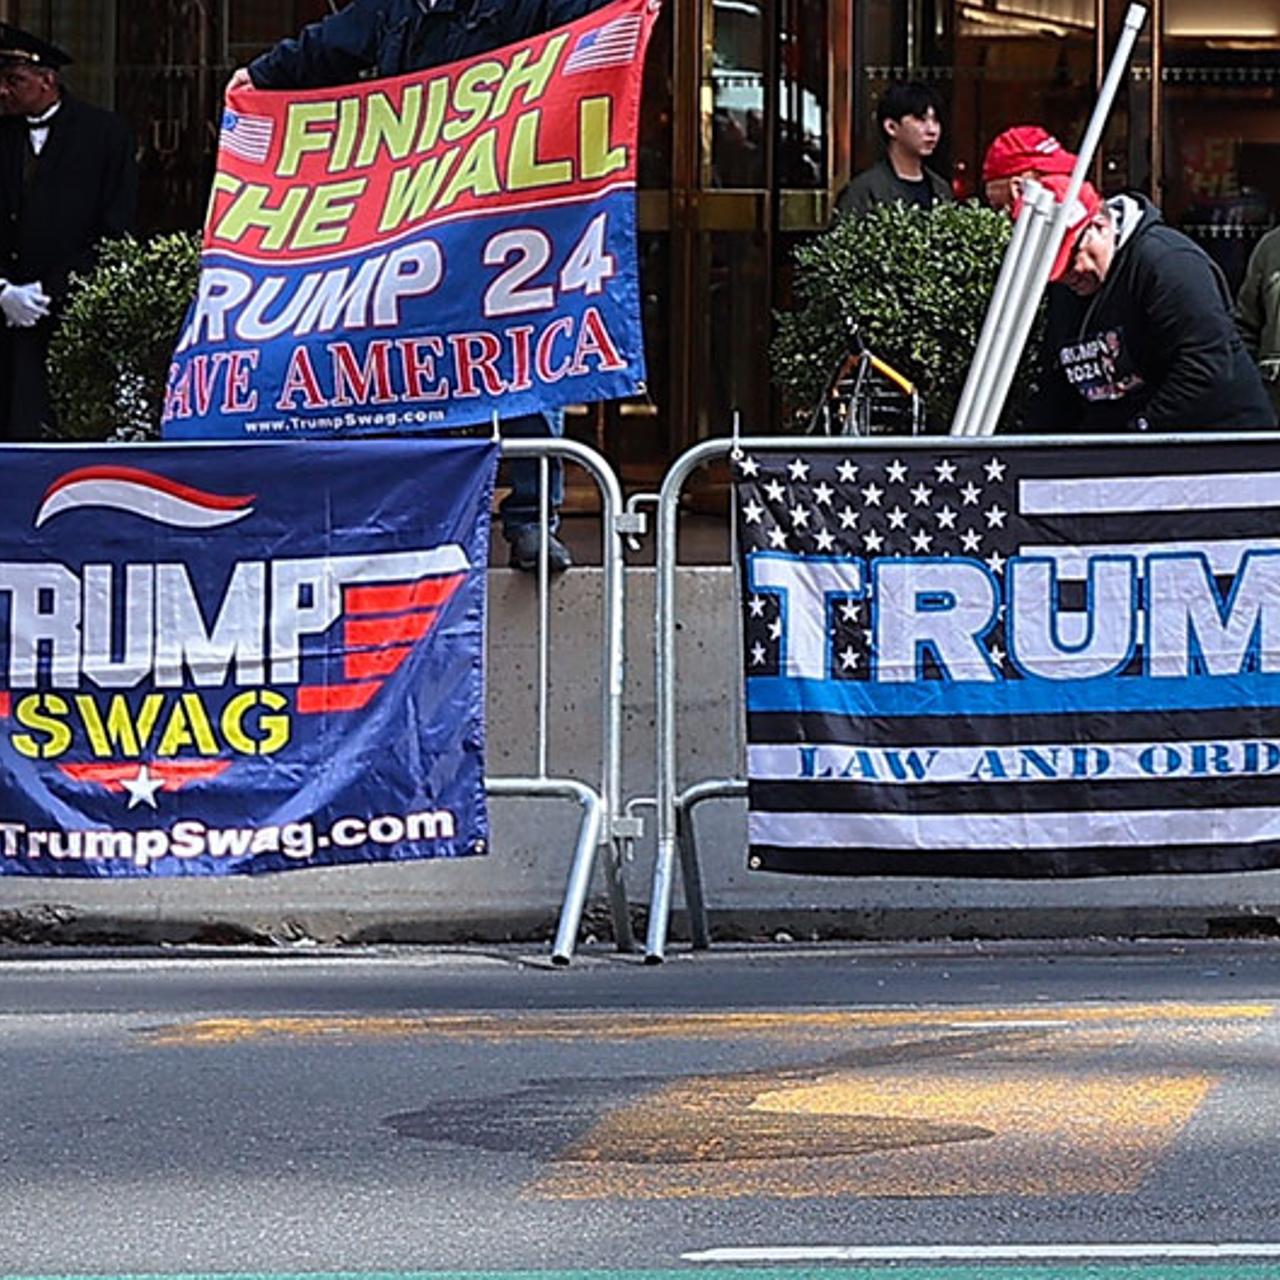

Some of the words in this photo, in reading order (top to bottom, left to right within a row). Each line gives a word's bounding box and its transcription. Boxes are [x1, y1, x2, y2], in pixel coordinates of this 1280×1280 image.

[276, 32, 573, 178] FINISH
[378, 96, 628, 233] WALL
[177, 239, 443, 352] RUMP
[483, 212, 614, 318] 24
[161, 349, 260, 424] AVE
[277, 307, 626, 410] AMERICA
[12, 690, 290, 758] SWAG
[799, 744, 936, 779] LAW
[969, 743, 1110, 780] AND
